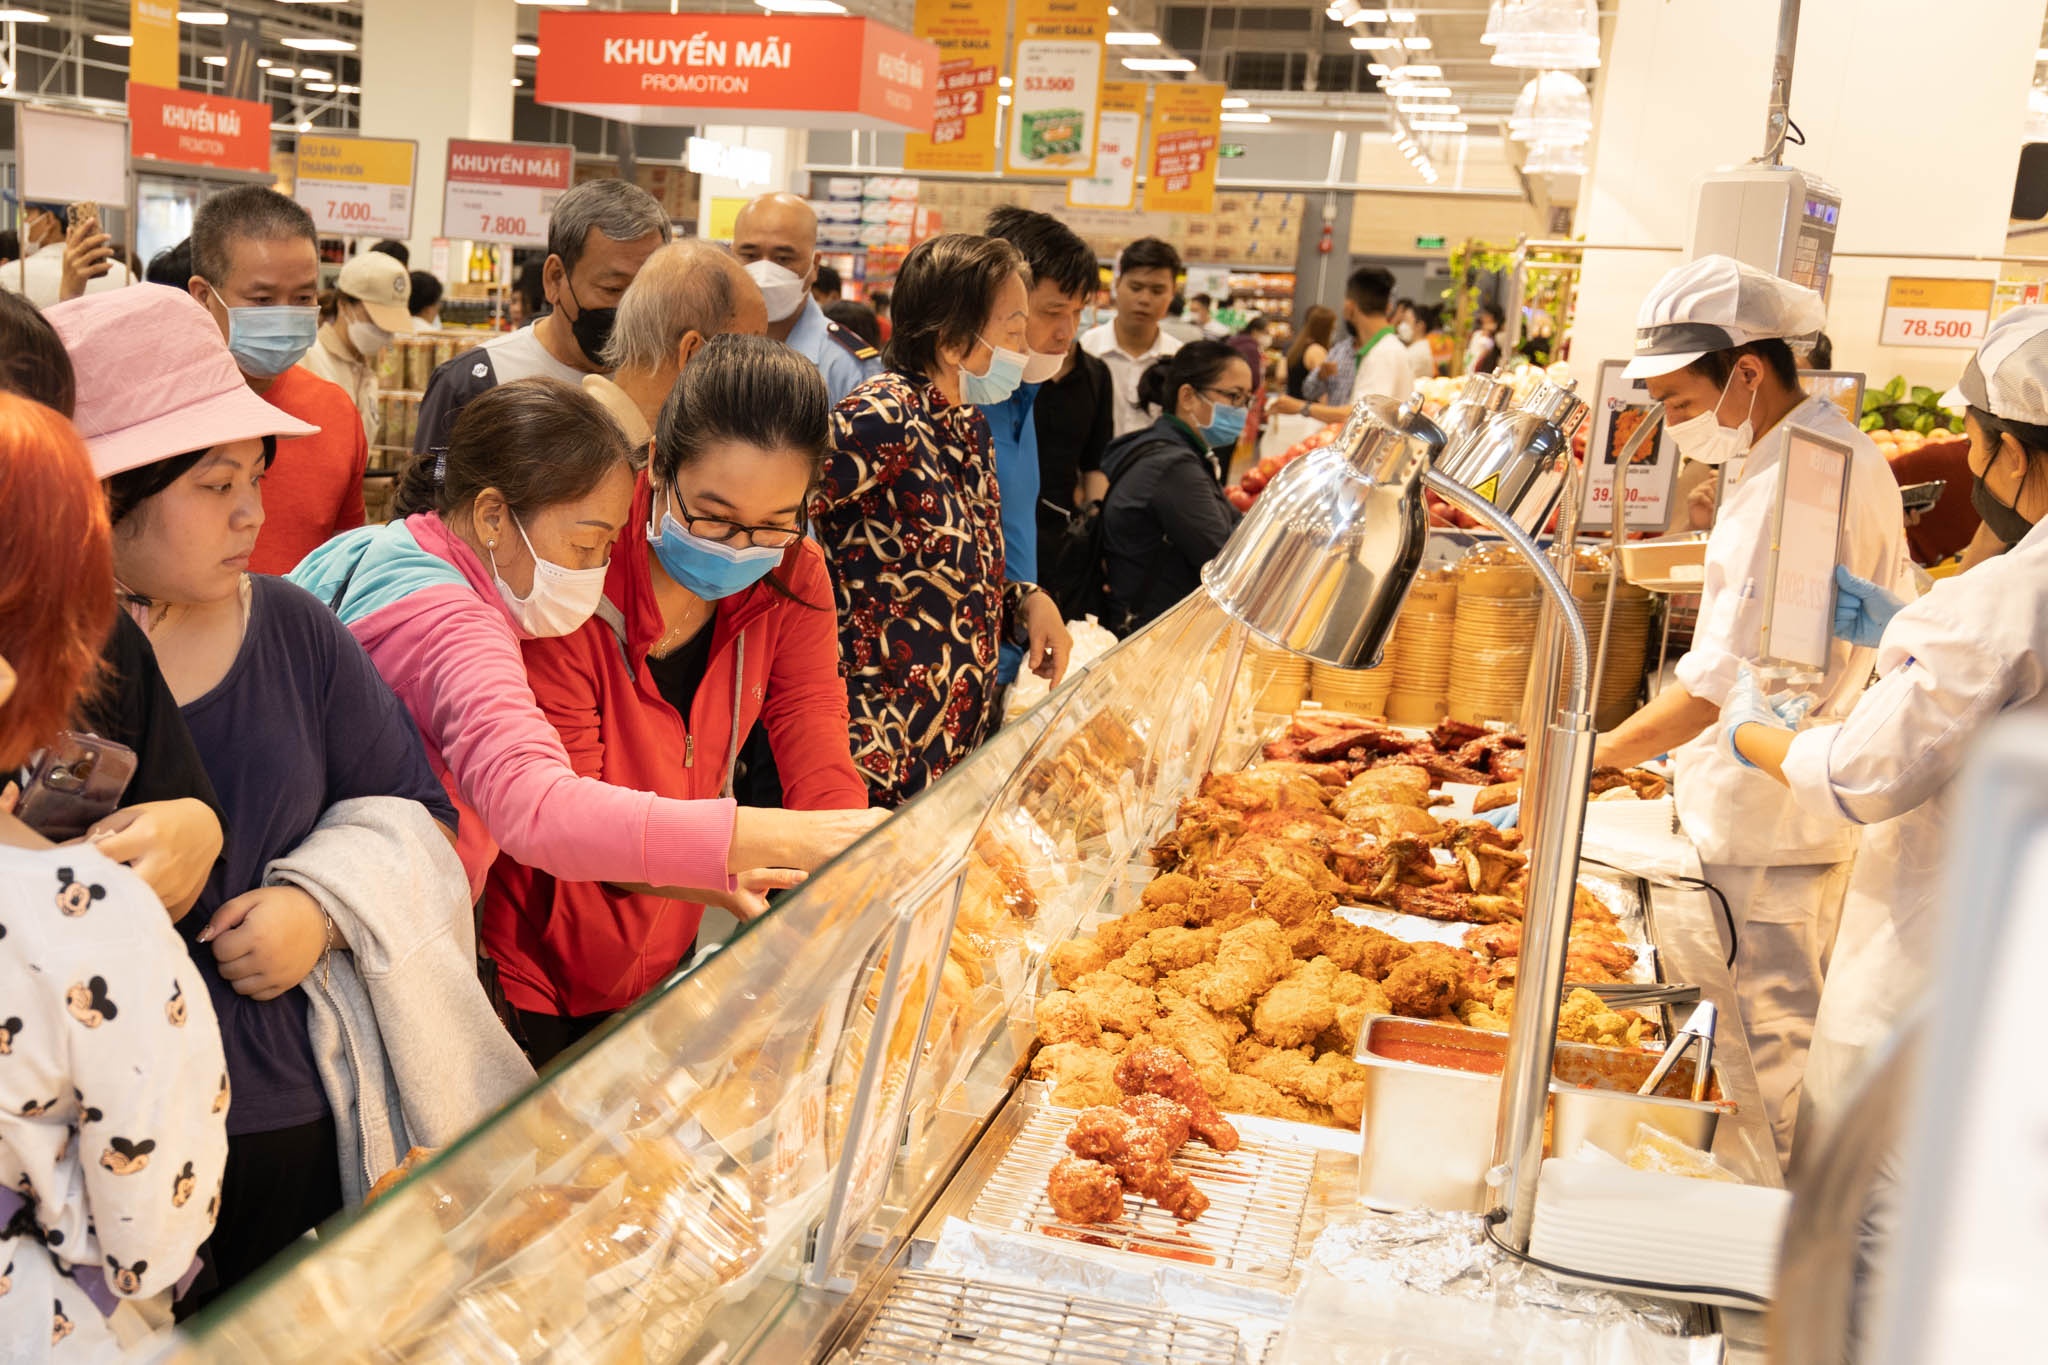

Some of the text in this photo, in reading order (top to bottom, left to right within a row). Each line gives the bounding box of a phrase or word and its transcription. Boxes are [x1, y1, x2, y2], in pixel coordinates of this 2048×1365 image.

[603, 31, 792, 68] KHUYẾN MÃI
[641, 73, 749, 94] PROMOTION
[961, 90, 977, 115] 2
[451, 152, 560, 178] KHUYẾN MÃI
[327, 200, 371, 221] 7.000
[481, 215, 527, 236] 7.800
[1903, 318, 1972, 339] 78.500
[1592, 487, 1639, 502] 39.00
